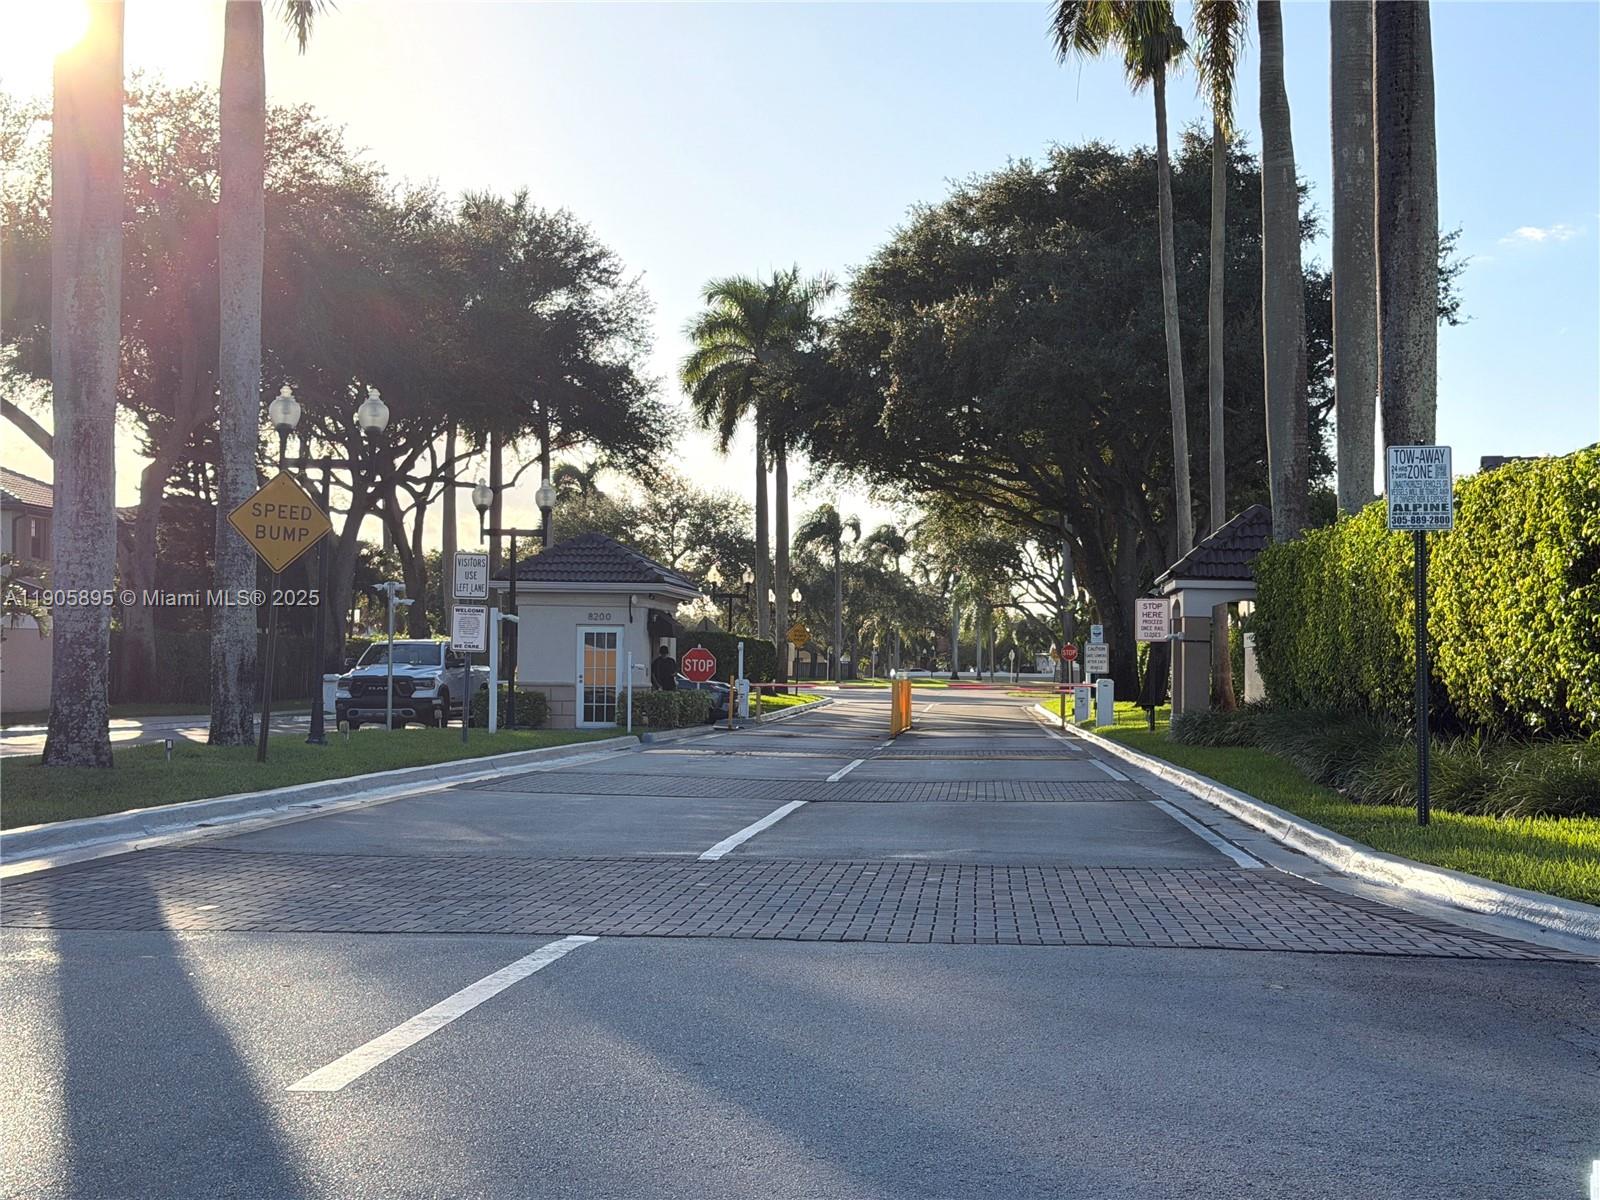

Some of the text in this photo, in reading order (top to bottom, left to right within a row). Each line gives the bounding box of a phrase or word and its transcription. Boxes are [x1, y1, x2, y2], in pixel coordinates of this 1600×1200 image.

[1394, 449, 1445, 464] TOW-AWAY
[1408, 465, 1433, 479] ZONE
[251, 502, 312, 521] SPEED
[1393, 503, 1450, 512] ALPINE
[1391, 515, 1450, 525] 305-889-2800
[255, 524, 310, 542] BUMP
[457, 557, 486, 568] VISITORS
[464, 571, 478, 580] USE
[456, 583, 486, 593] LEFT LANE
[1142, 602, 1163, 610] STOP
[587, 612, 612, 621] 8200
[1141, 611, 1164, 619] HERE
[684, 659, 714, 672] STOP
